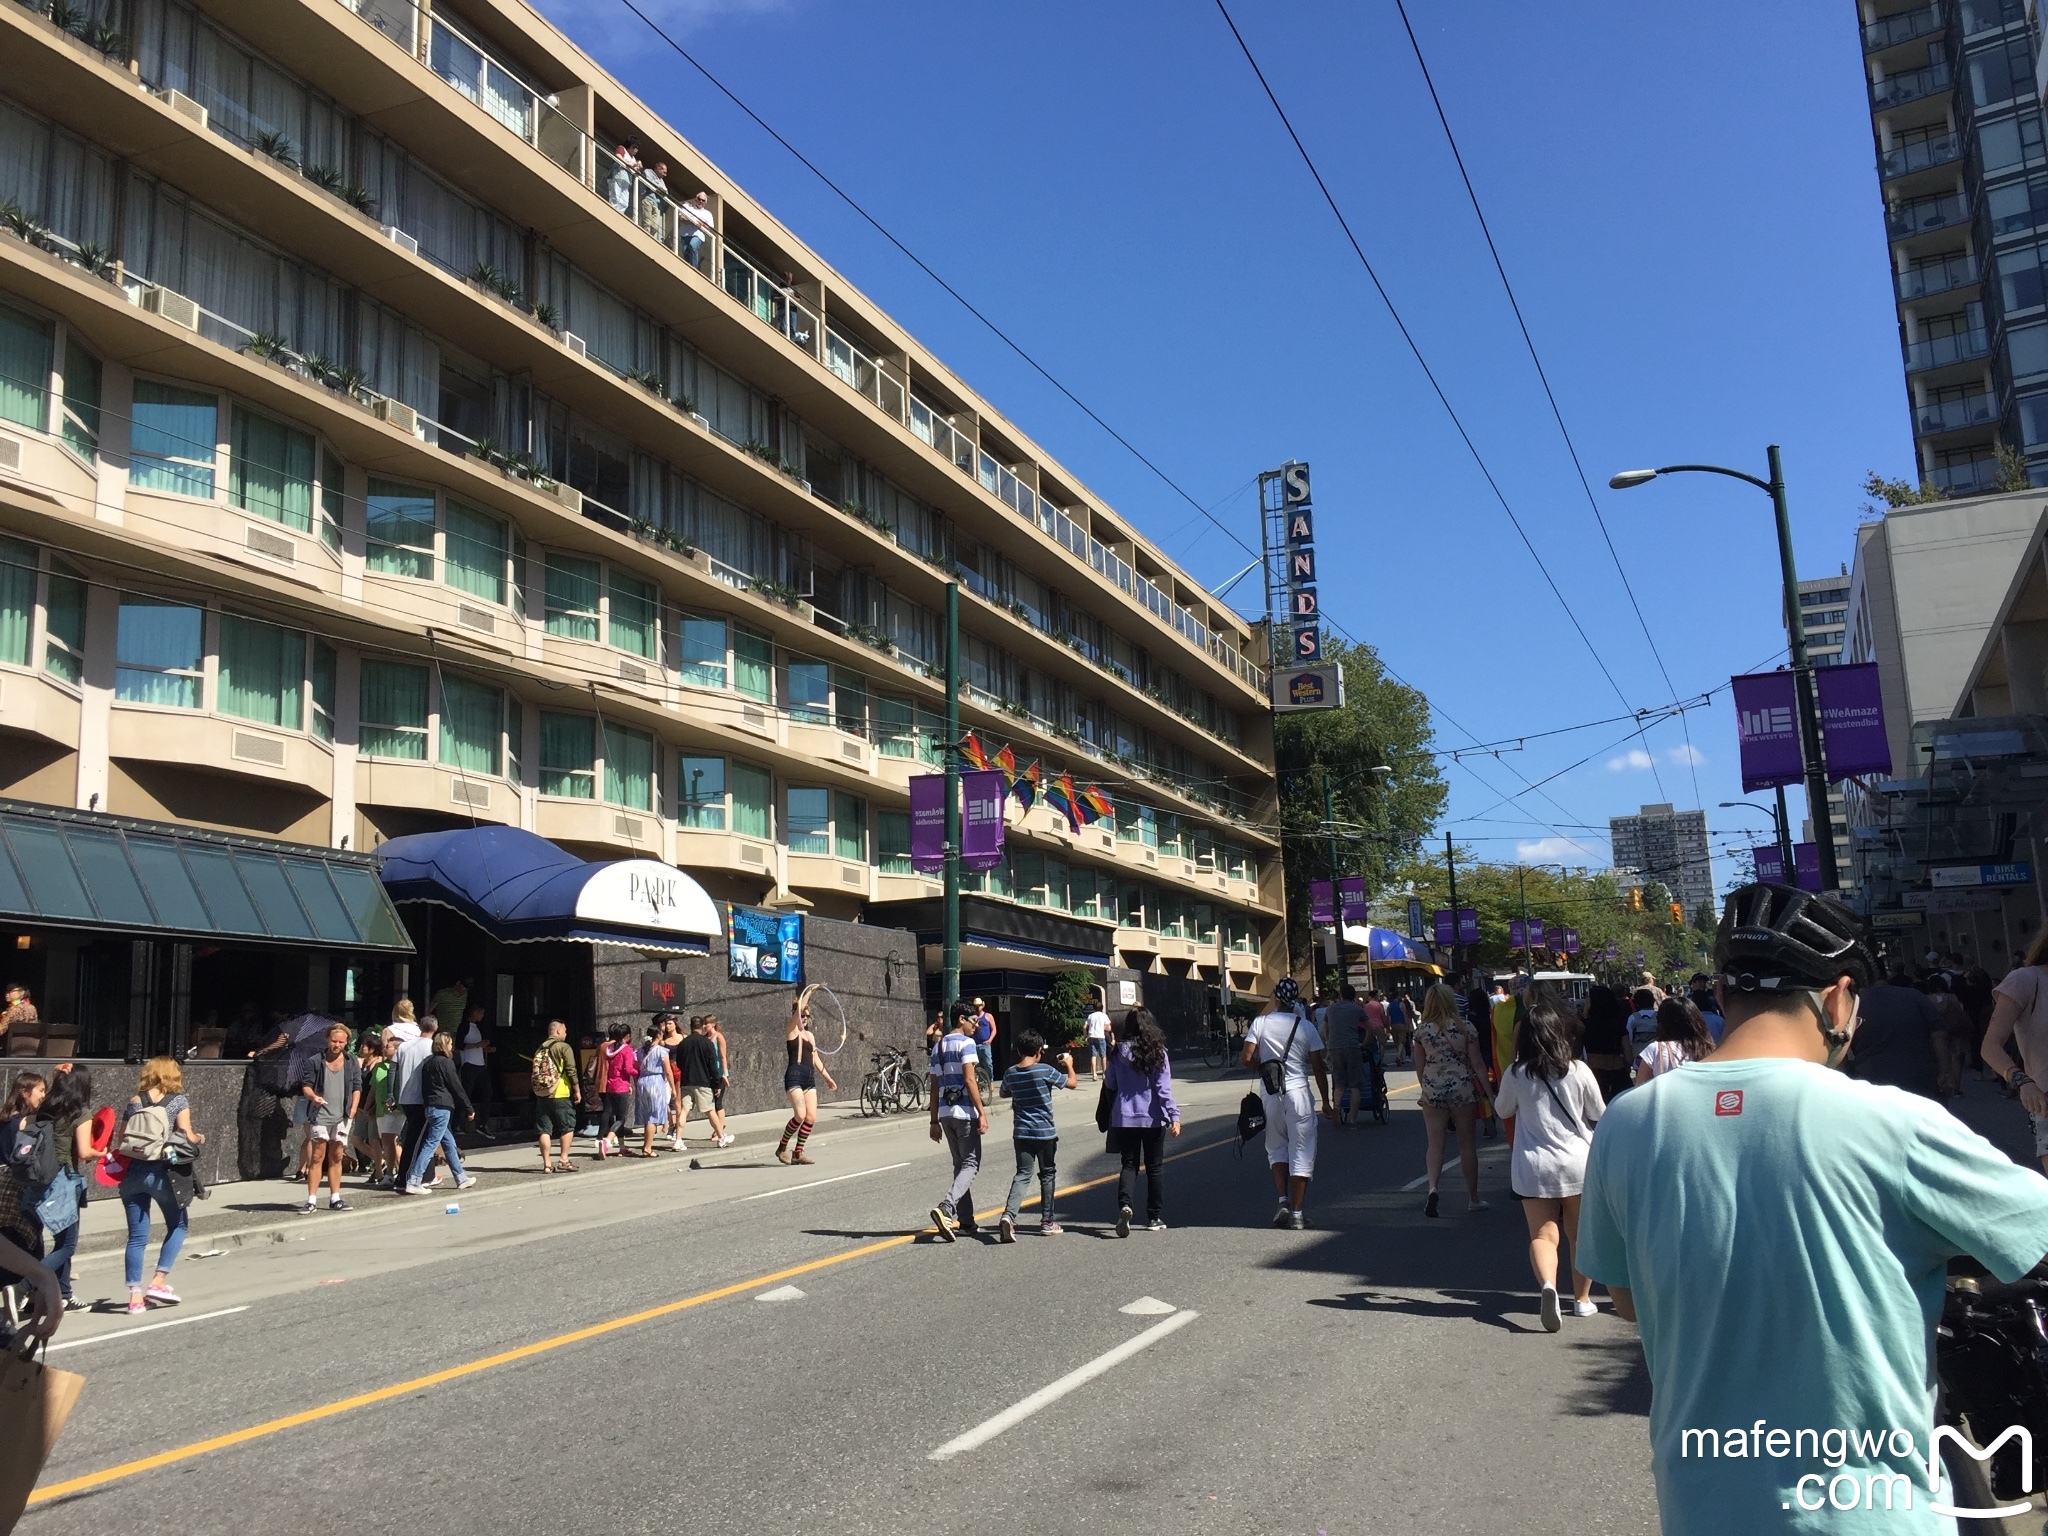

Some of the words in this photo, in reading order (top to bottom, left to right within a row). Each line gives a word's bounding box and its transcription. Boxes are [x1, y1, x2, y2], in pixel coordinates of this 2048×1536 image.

[1286, 465, 1316, 655] SANDS
[1298, 682, 1314, 690] Best
[1292, 688, 1321, 697] Western
[1823, 707, 1878, 719] #WeAmaze
[1745, 734, 1758, 742] THE
[1759, 733, 1778, 741] WEST
[1994, 864, 2016, 874] BIKE
[1986, 872, 2027, 882] RENTALS
[630, 873, 677, 907] PARK
[1937, 900, 1953, 910] Tim
[652, 981, 675, 998] PARK
